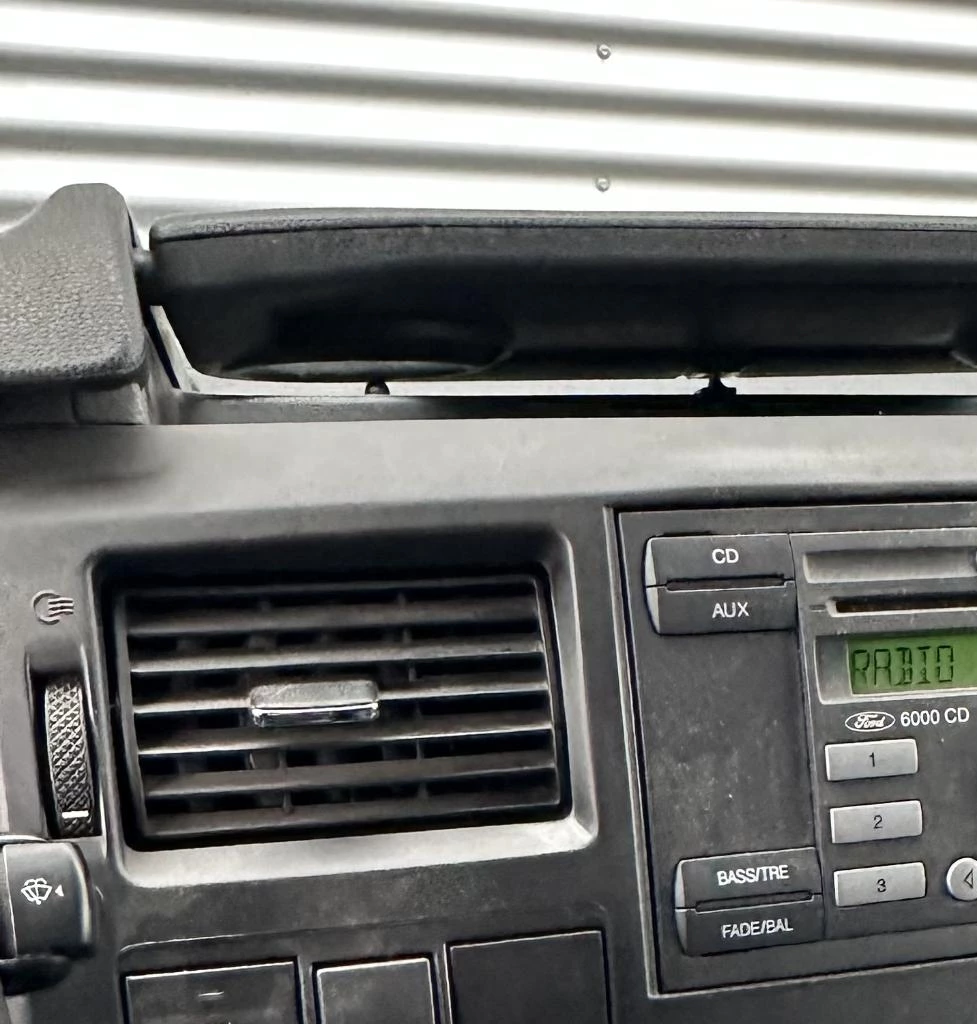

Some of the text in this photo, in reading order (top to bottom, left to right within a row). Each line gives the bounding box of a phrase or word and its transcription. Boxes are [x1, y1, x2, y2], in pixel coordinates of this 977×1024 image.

[712, 548, 739, 564] CD
[712, 602, 749, 618] AUX
[852, 645, 955, 687] RADIO
[900, 707, 970, 727] 6000 CD
[869, 752, 877, 767] 1
[873, 815, 883, 829] 2
[717, 865, 789, 886] BASS/TRE
[876, 879, 887, 893] 3
[722, 918, 793, 938] FADE/BAL
